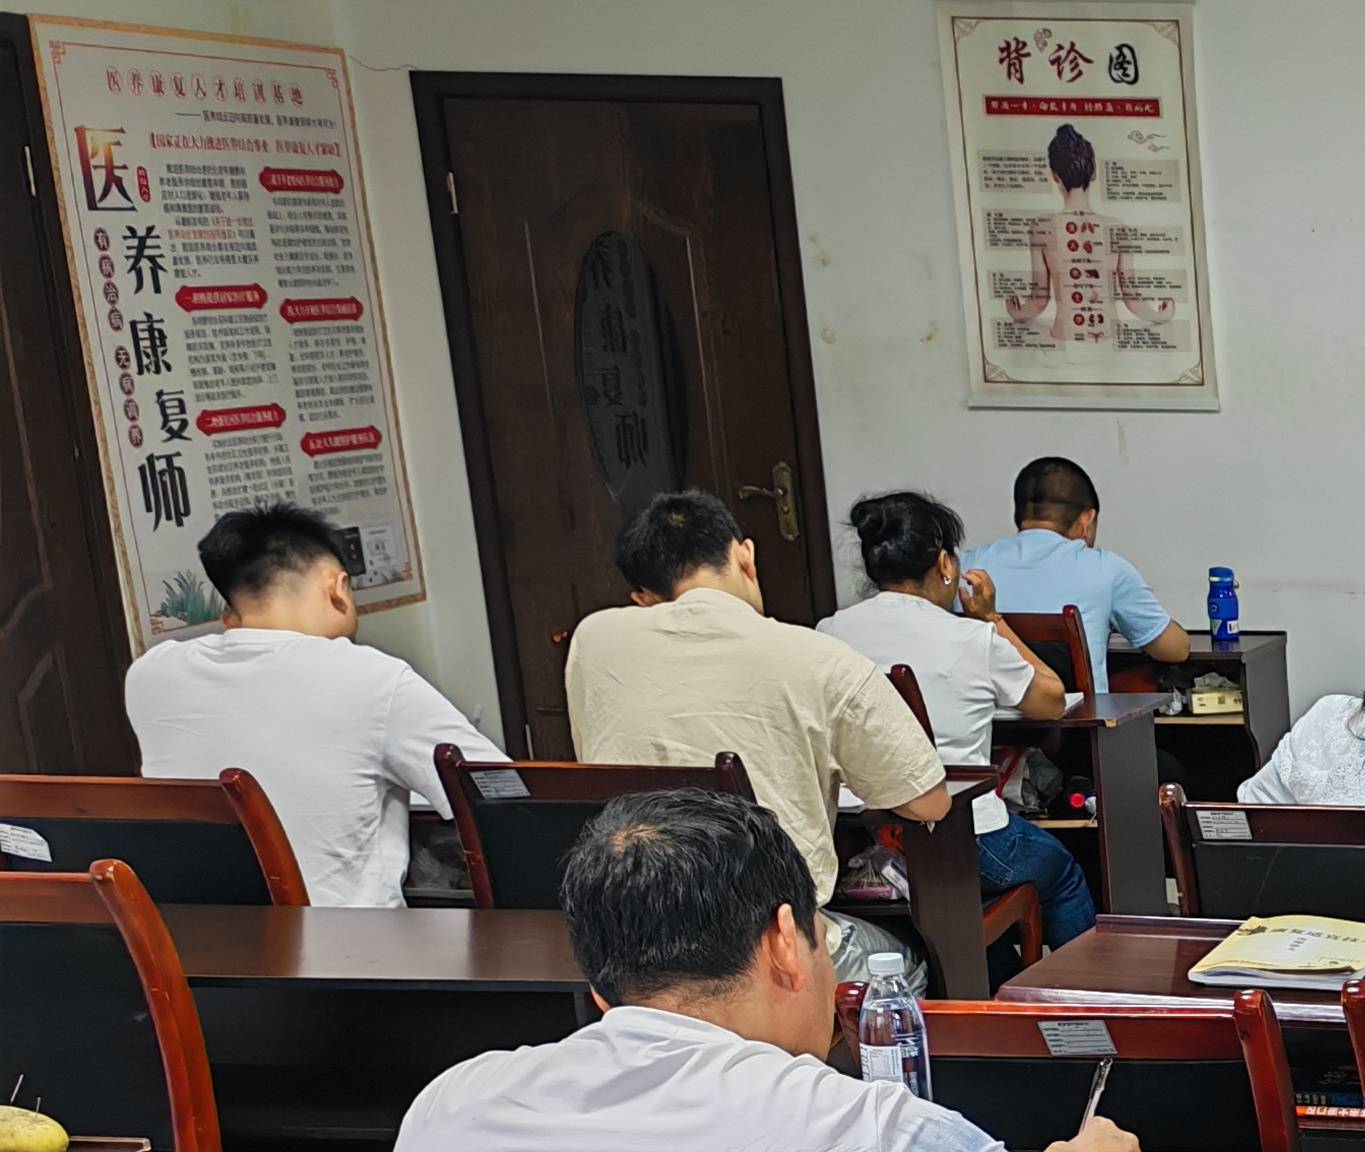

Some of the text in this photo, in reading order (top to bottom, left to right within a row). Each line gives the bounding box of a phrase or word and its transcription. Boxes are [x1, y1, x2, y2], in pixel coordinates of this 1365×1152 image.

[998, 36, 1139, 85] 背诊图
[74, 126, 192, 532] 医养康复师
